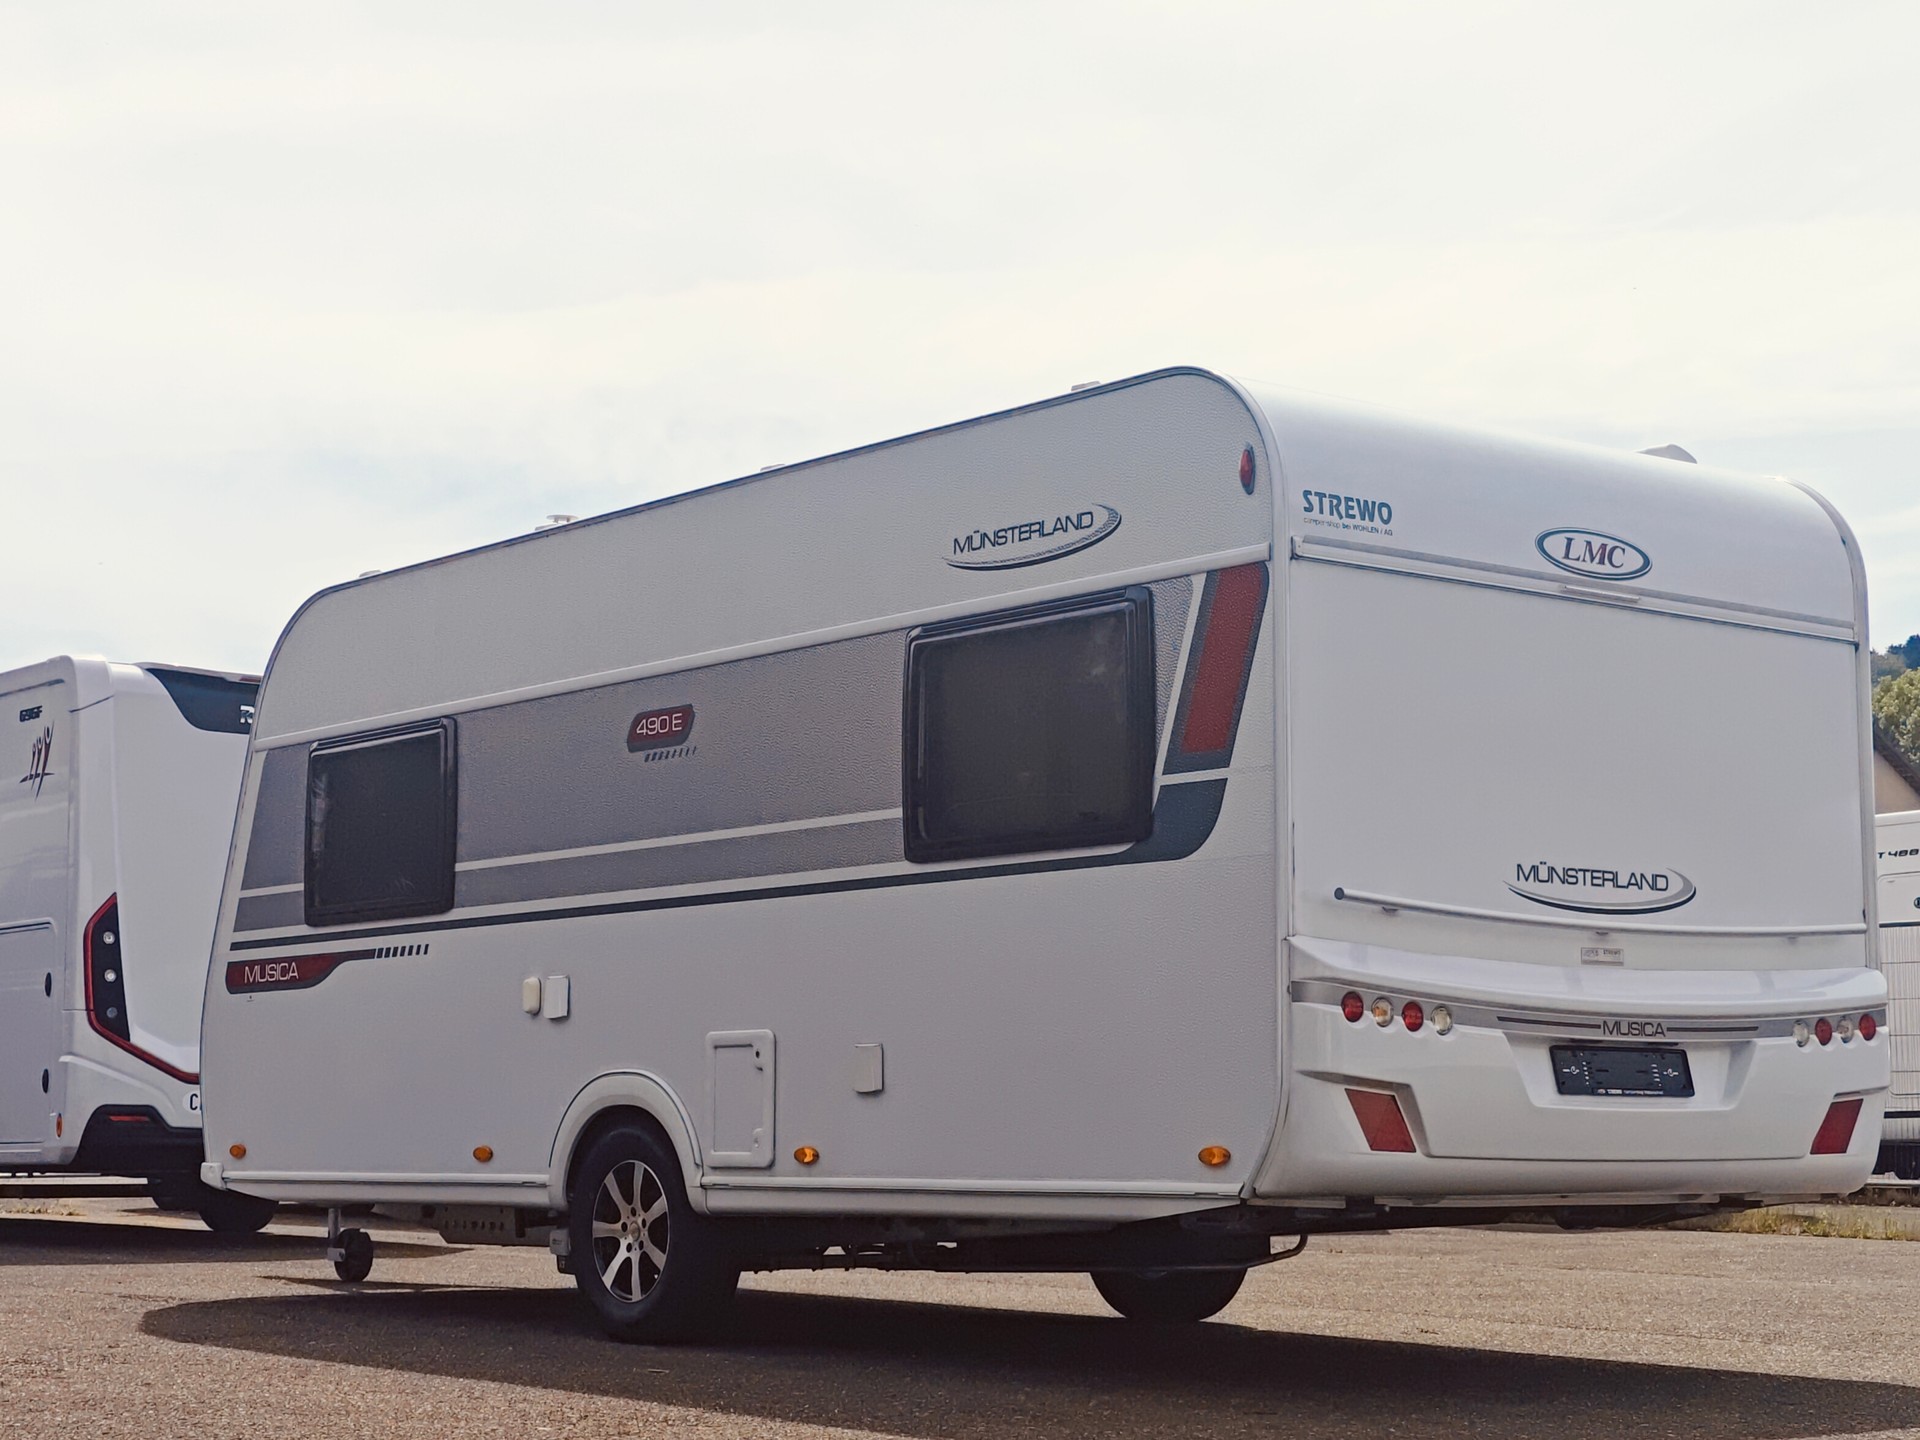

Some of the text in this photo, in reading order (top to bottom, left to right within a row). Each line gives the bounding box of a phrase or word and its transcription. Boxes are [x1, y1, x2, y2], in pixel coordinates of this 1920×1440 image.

[1302, 489, 1393, 525] STREWO
[953, 511, 1094, 556] MÜNSTERLAND
[1352, 523, 1379, 535] WOHLEN
[1562, 536, 1626, 569] LMC
[636, 713, 683, 736] 490 E
[1516, 861, 1669, 892] MÜNSTERLAND
[244, 961, 299, 984] MUSICA
[1602, 1020, 1666, 1038] MUSICA
